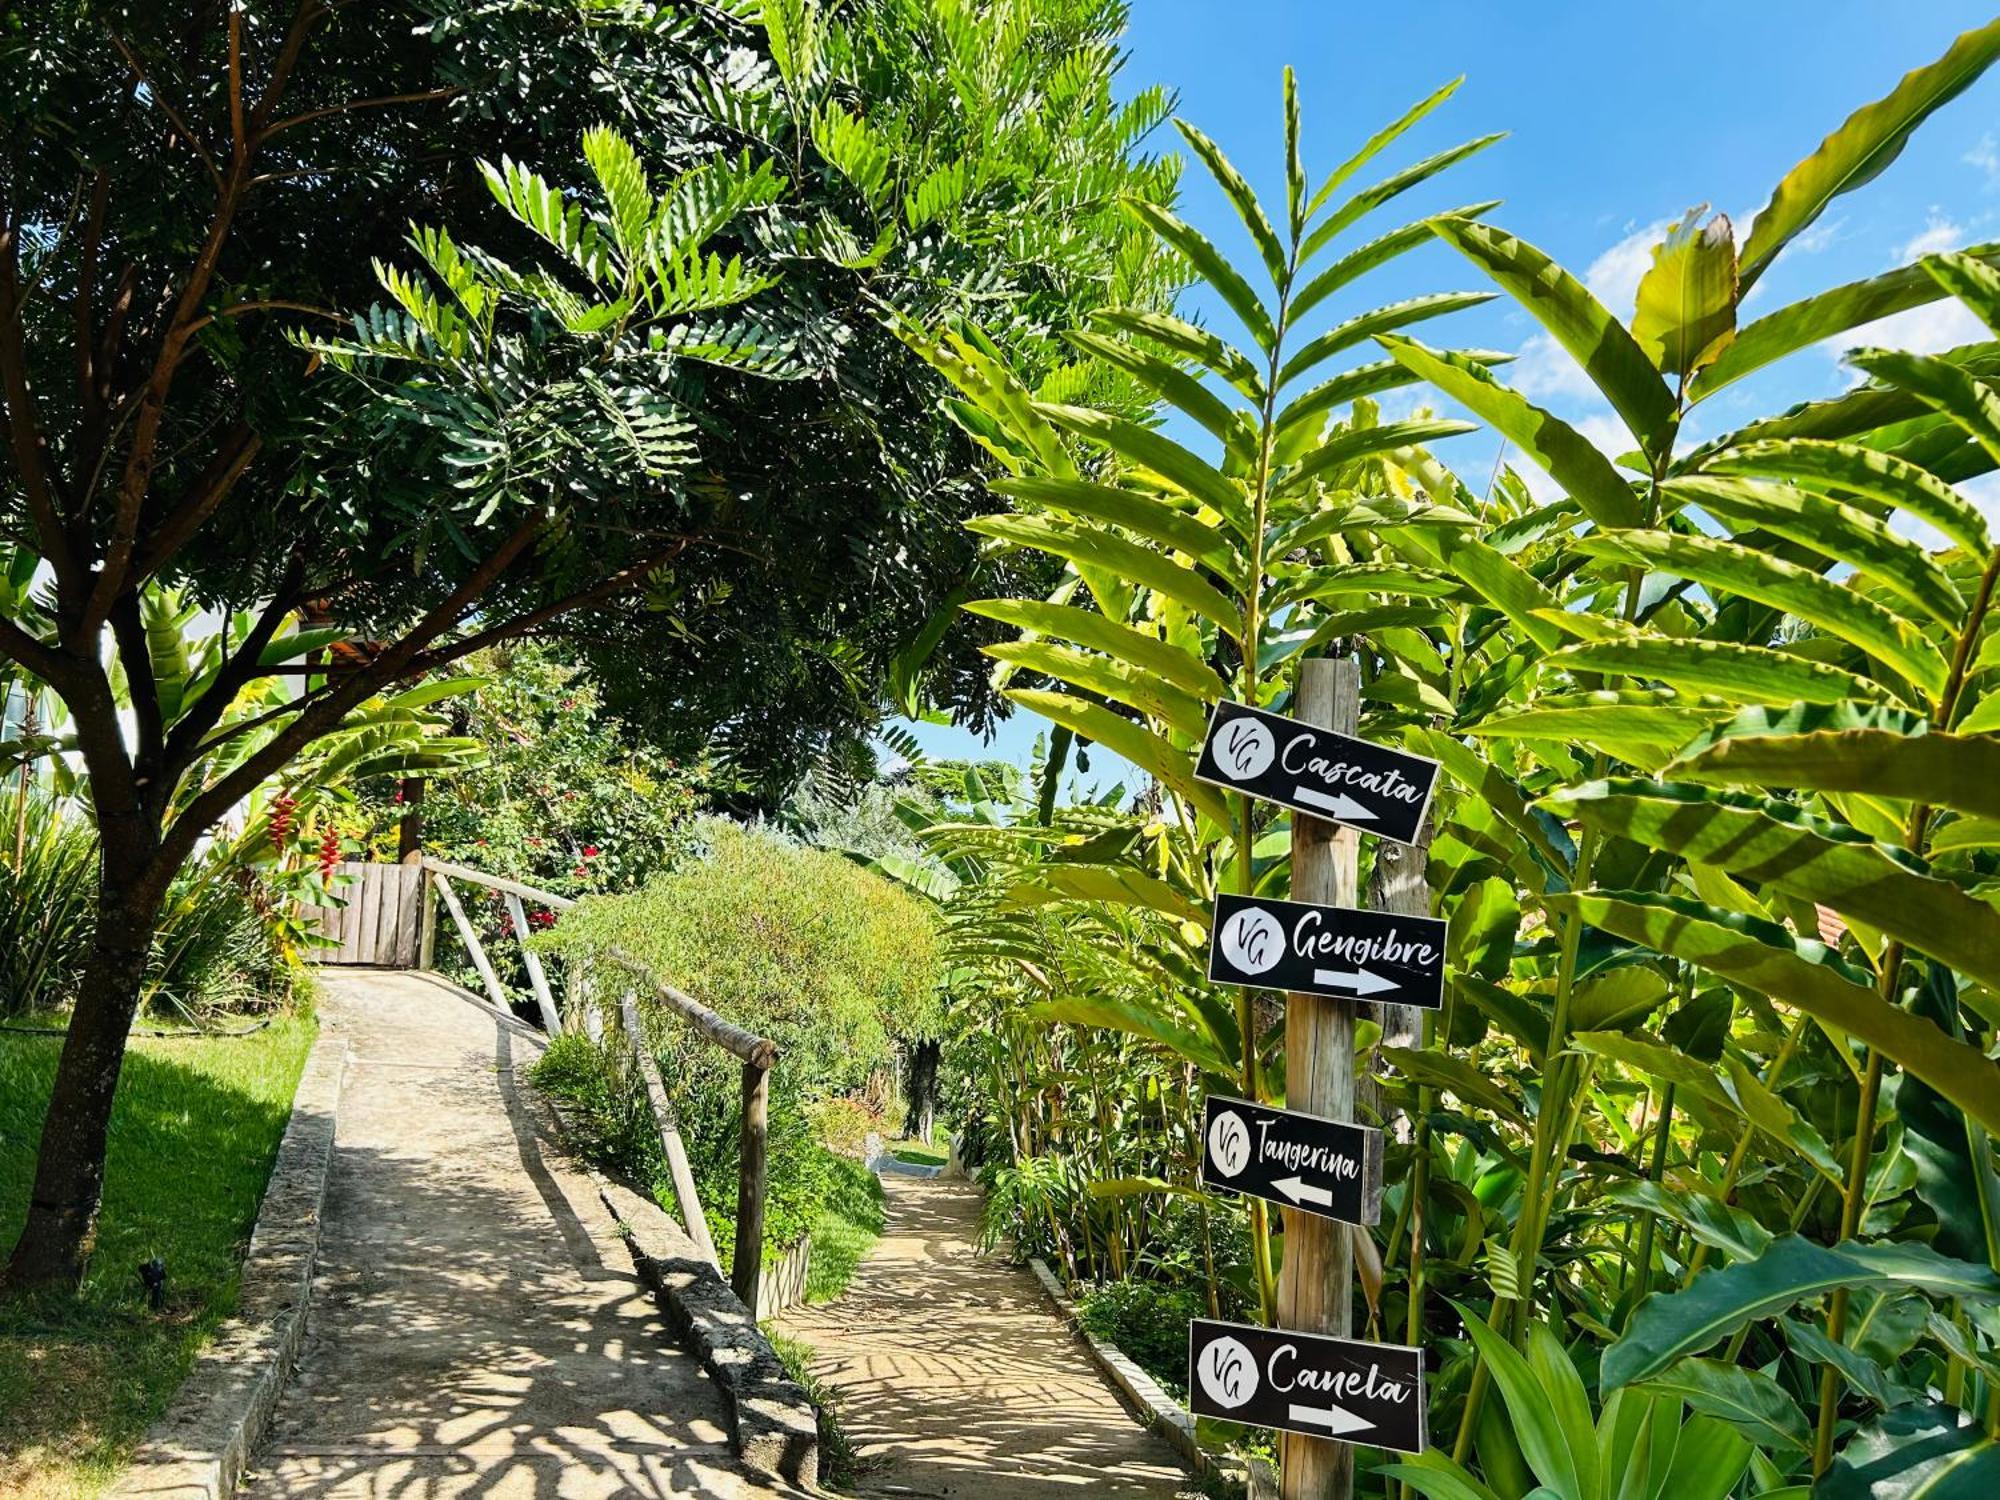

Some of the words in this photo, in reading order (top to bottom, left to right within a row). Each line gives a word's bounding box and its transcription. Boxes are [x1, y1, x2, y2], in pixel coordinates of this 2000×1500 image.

[1229, 725, 1260, 774] VG
[1281, 733, 1424, 804] Cascata
[1238, 917, 1268, 966] VG
[1293, 910, 1440, 965] Gengibre
[1219, 1119, 1240, 1169] VG
[1256, 1118, 1360, 1181] Tangerina
[1213, 1346, 1242, 1400] VG
[1267, 1344, 1411, 1404] Canela
